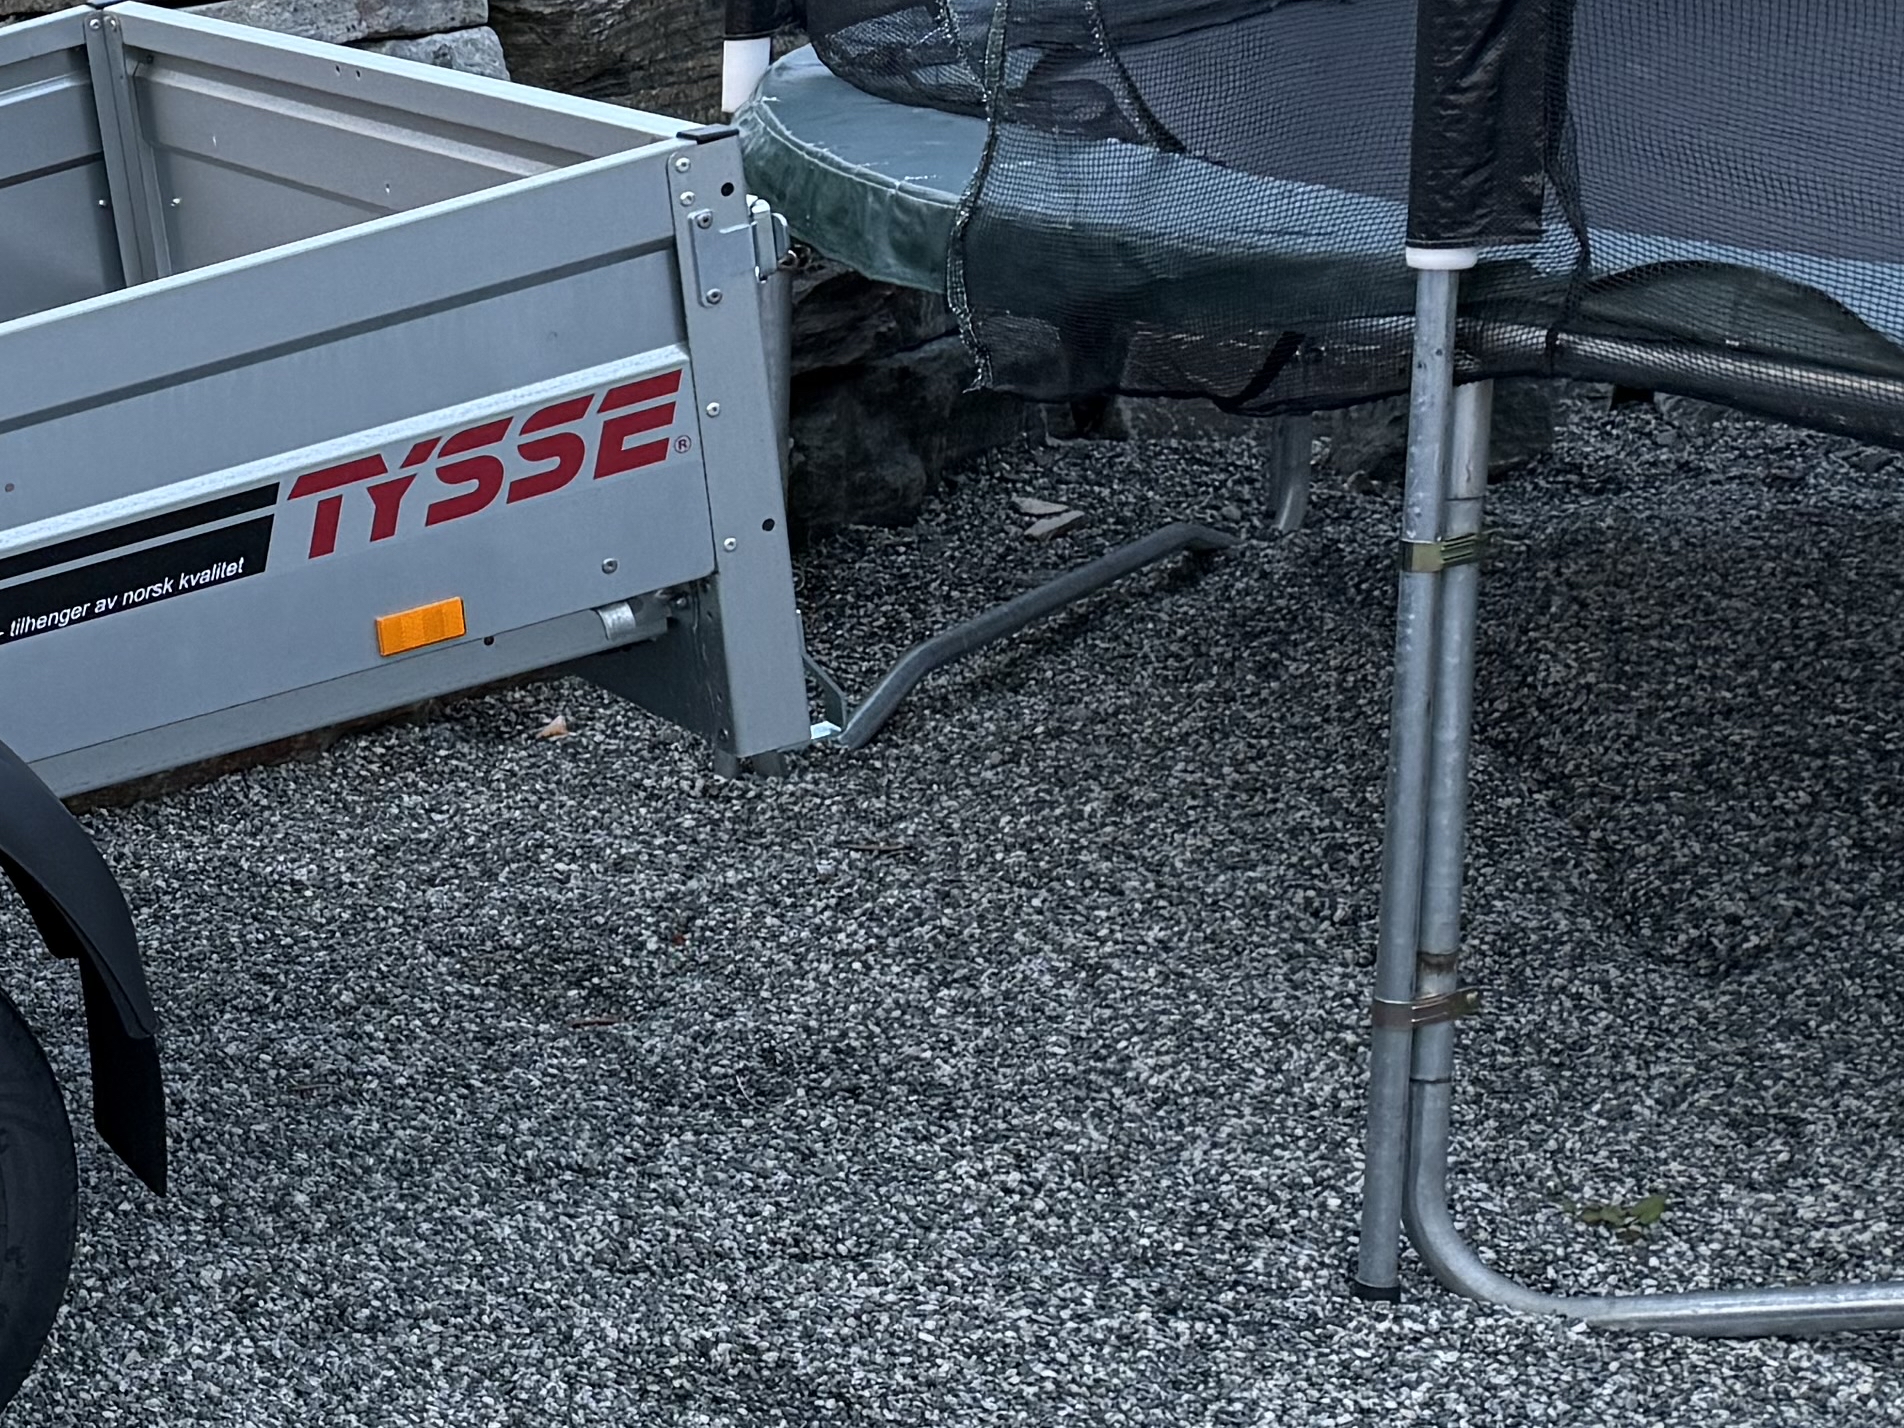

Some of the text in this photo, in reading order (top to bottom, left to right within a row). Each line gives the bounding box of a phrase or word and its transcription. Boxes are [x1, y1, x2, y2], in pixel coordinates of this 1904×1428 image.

[287, 369, 683, 559] TYSSE
[9, 602, 91, 637] tilhenger
[94, 594, 119, 614] av
[121, 576, 175, 606] norsk
[178, 556, 245, 591] kvalitet
